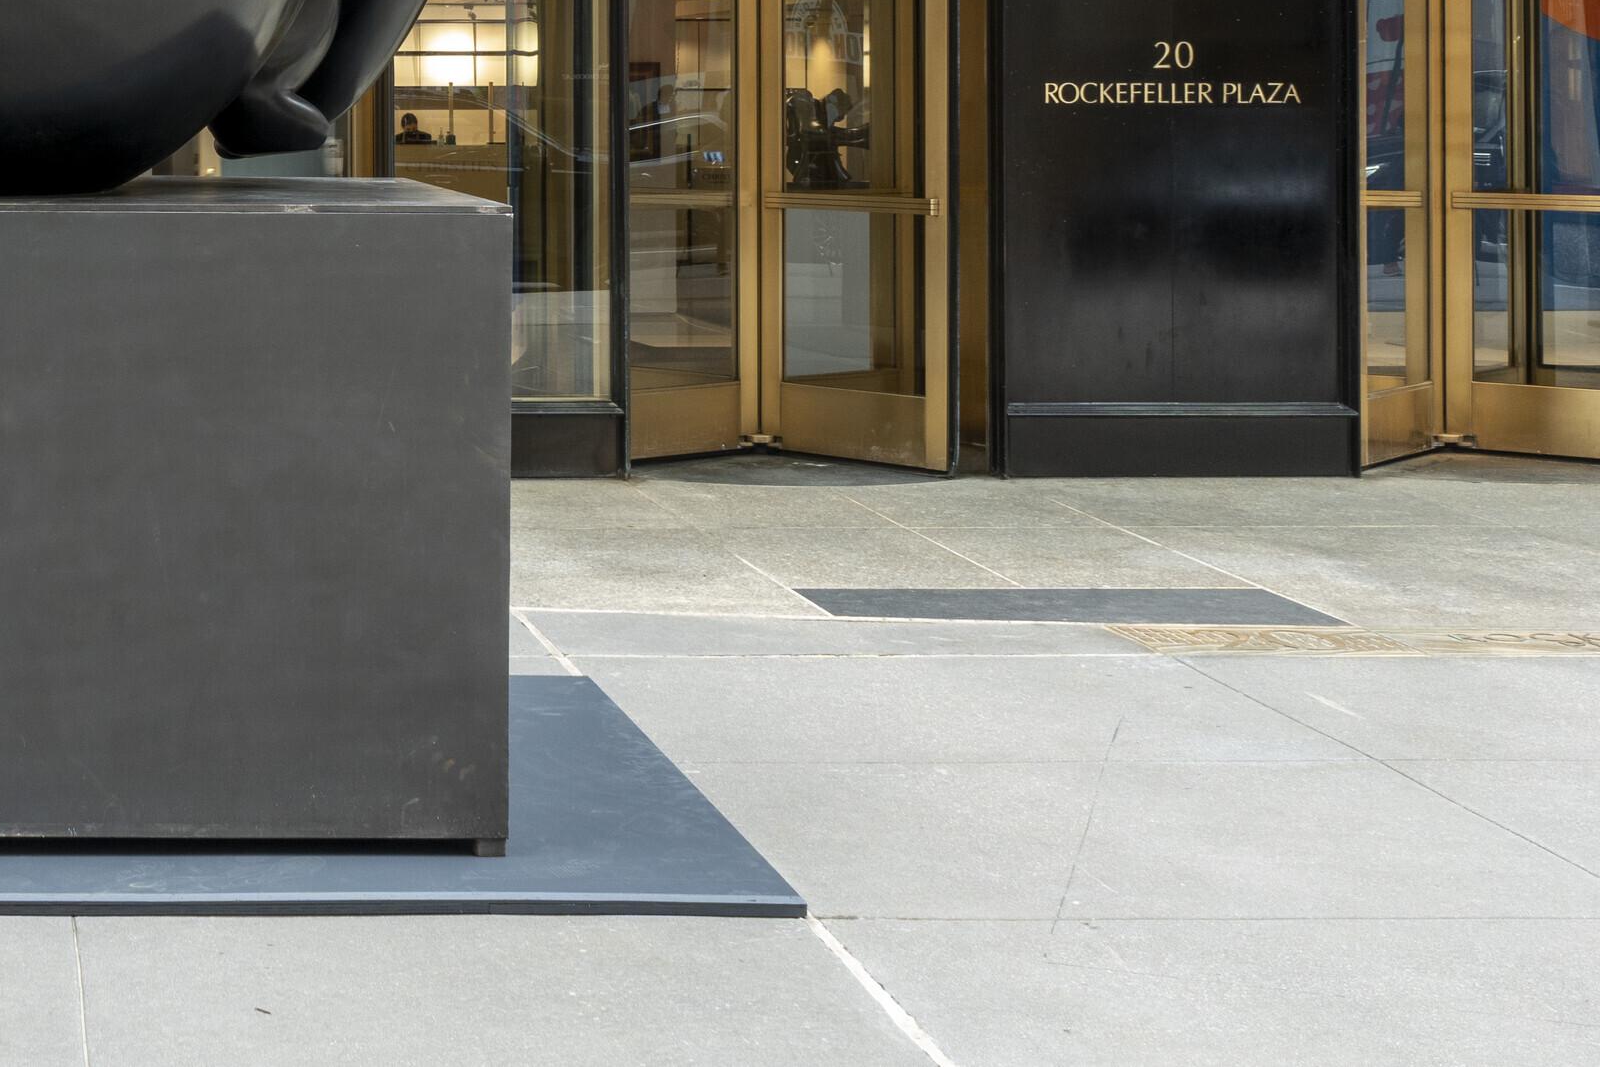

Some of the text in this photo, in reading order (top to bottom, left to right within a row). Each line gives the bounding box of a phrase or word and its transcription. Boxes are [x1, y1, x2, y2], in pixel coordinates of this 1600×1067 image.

[1153, 41, 1194, 69] 20
[1044, 82, 1301, 104] ROCKEFELLER PLAZA
